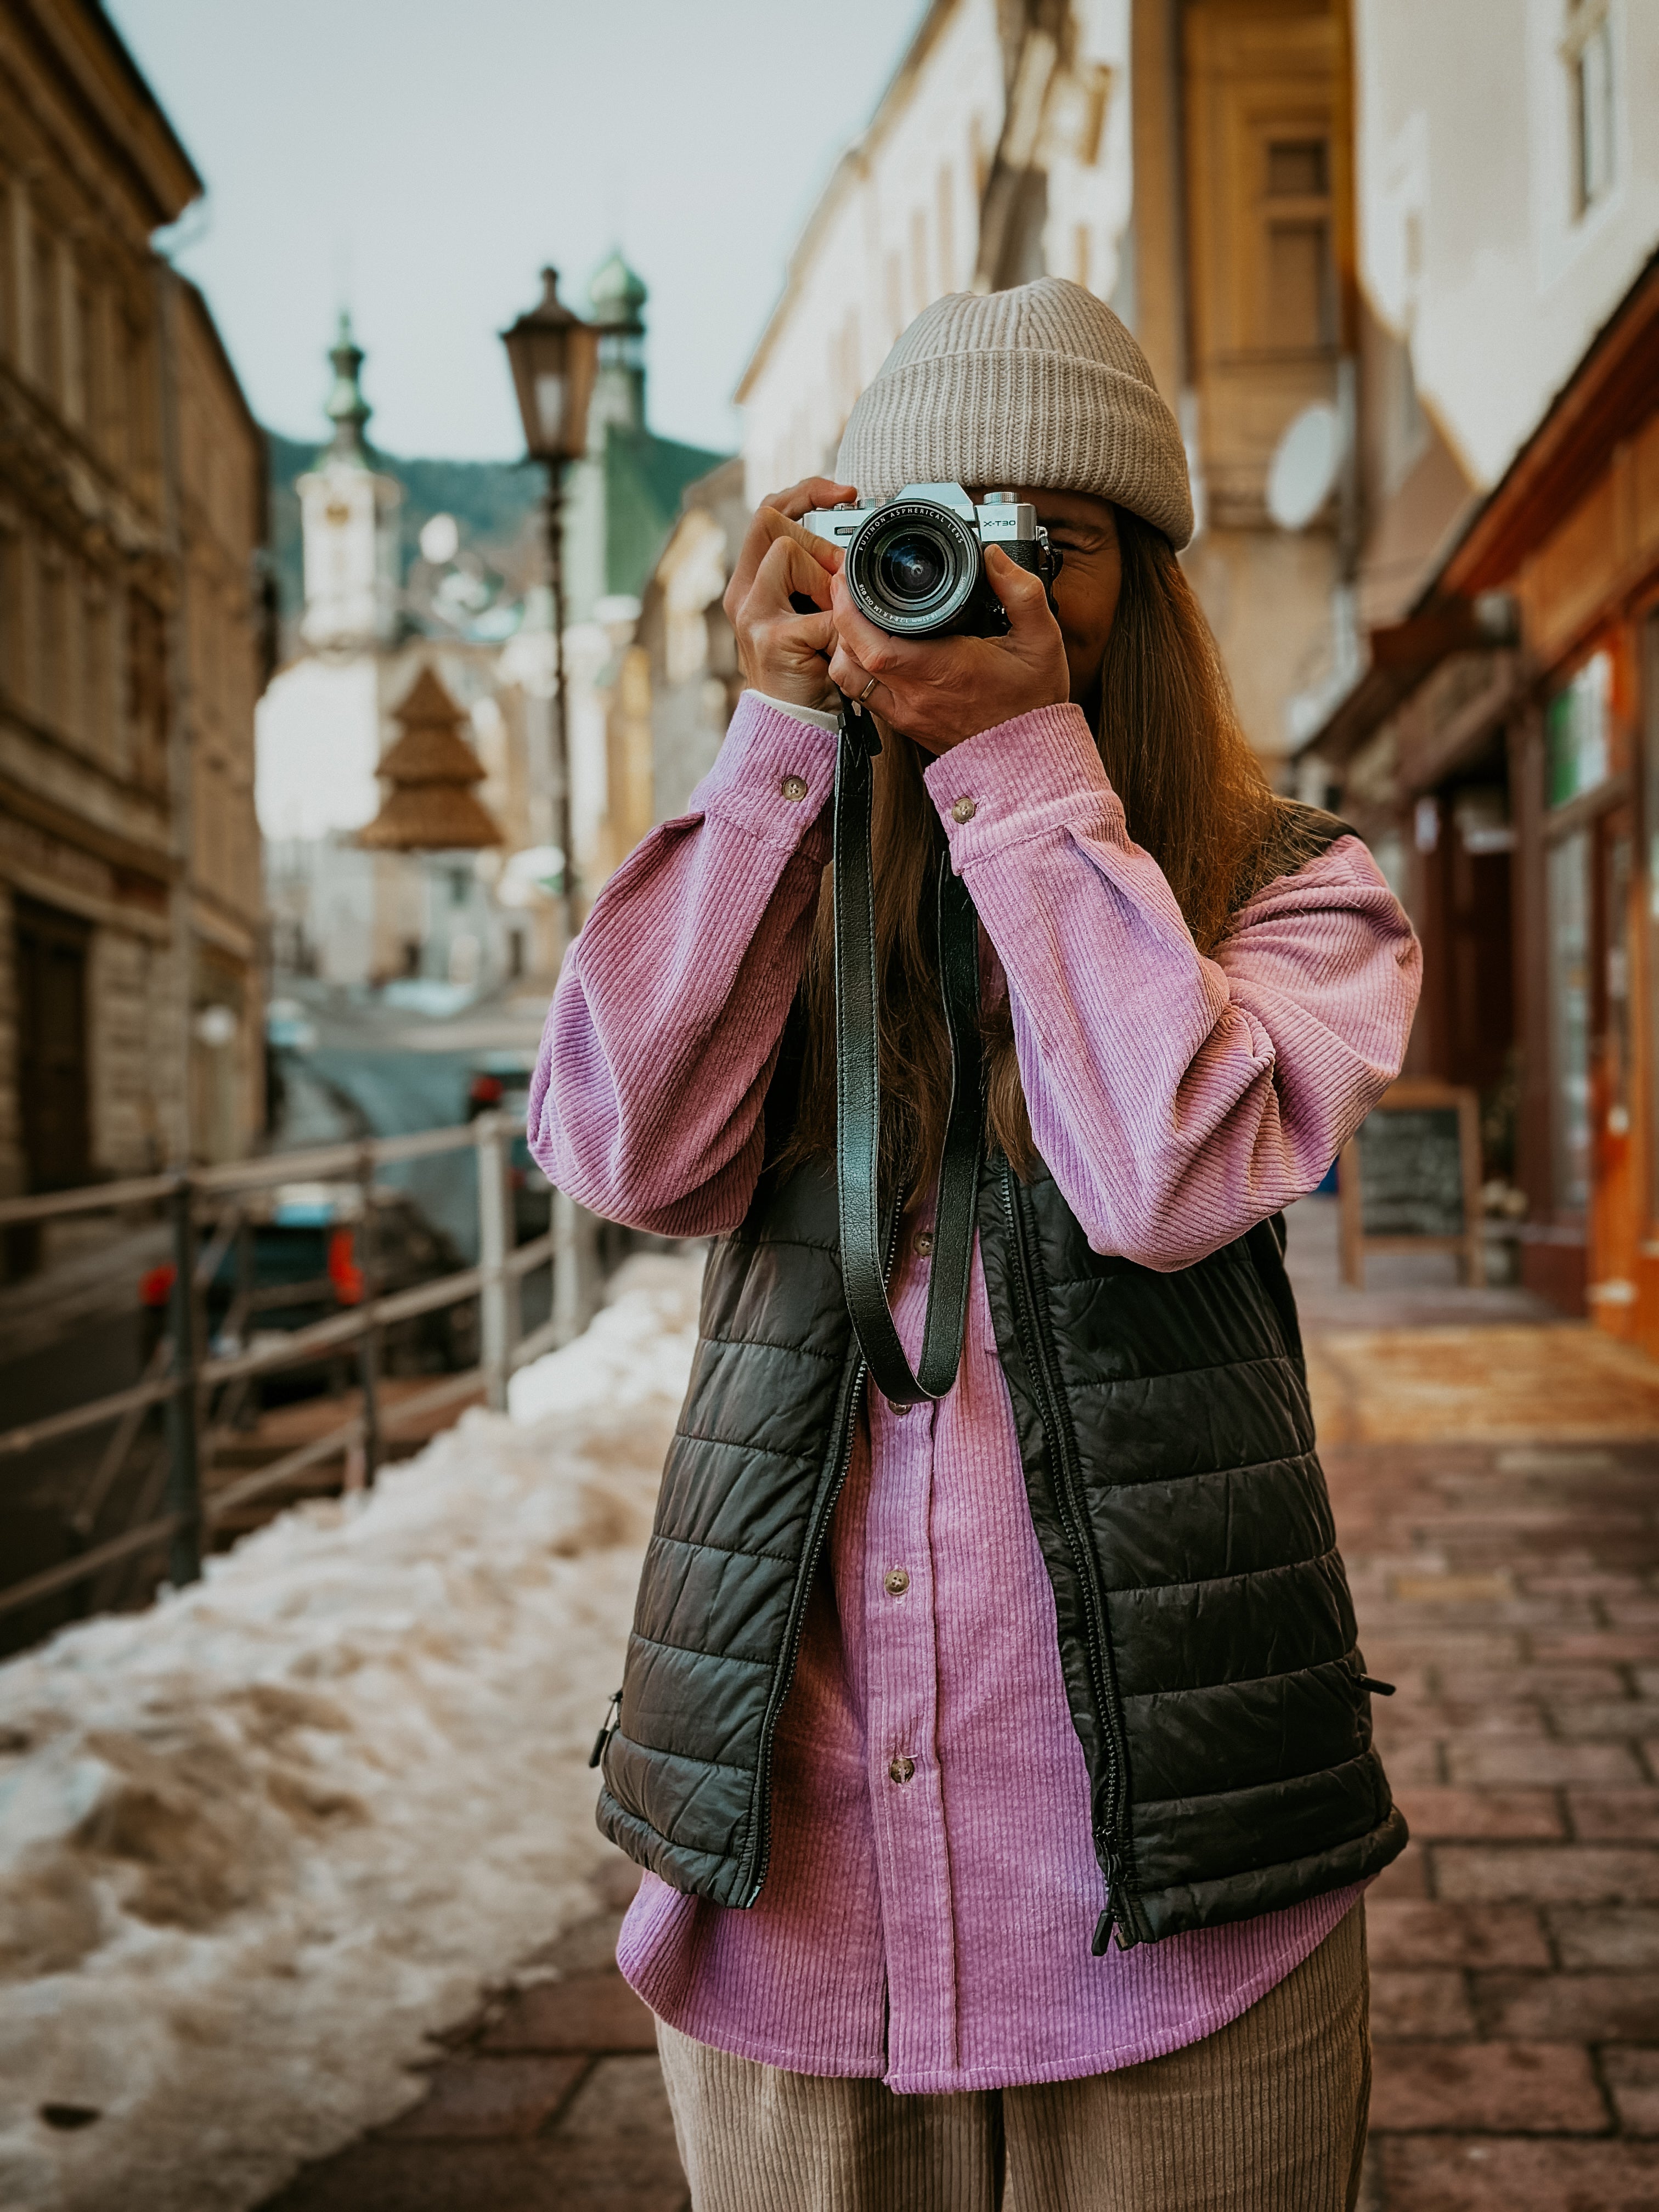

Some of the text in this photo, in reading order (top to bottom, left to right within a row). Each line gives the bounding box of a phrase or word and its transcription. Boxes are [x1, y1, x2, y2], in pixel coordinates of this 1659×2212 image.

[859, 507, 963, 551] FUJINON ASPHERICAL LENS
